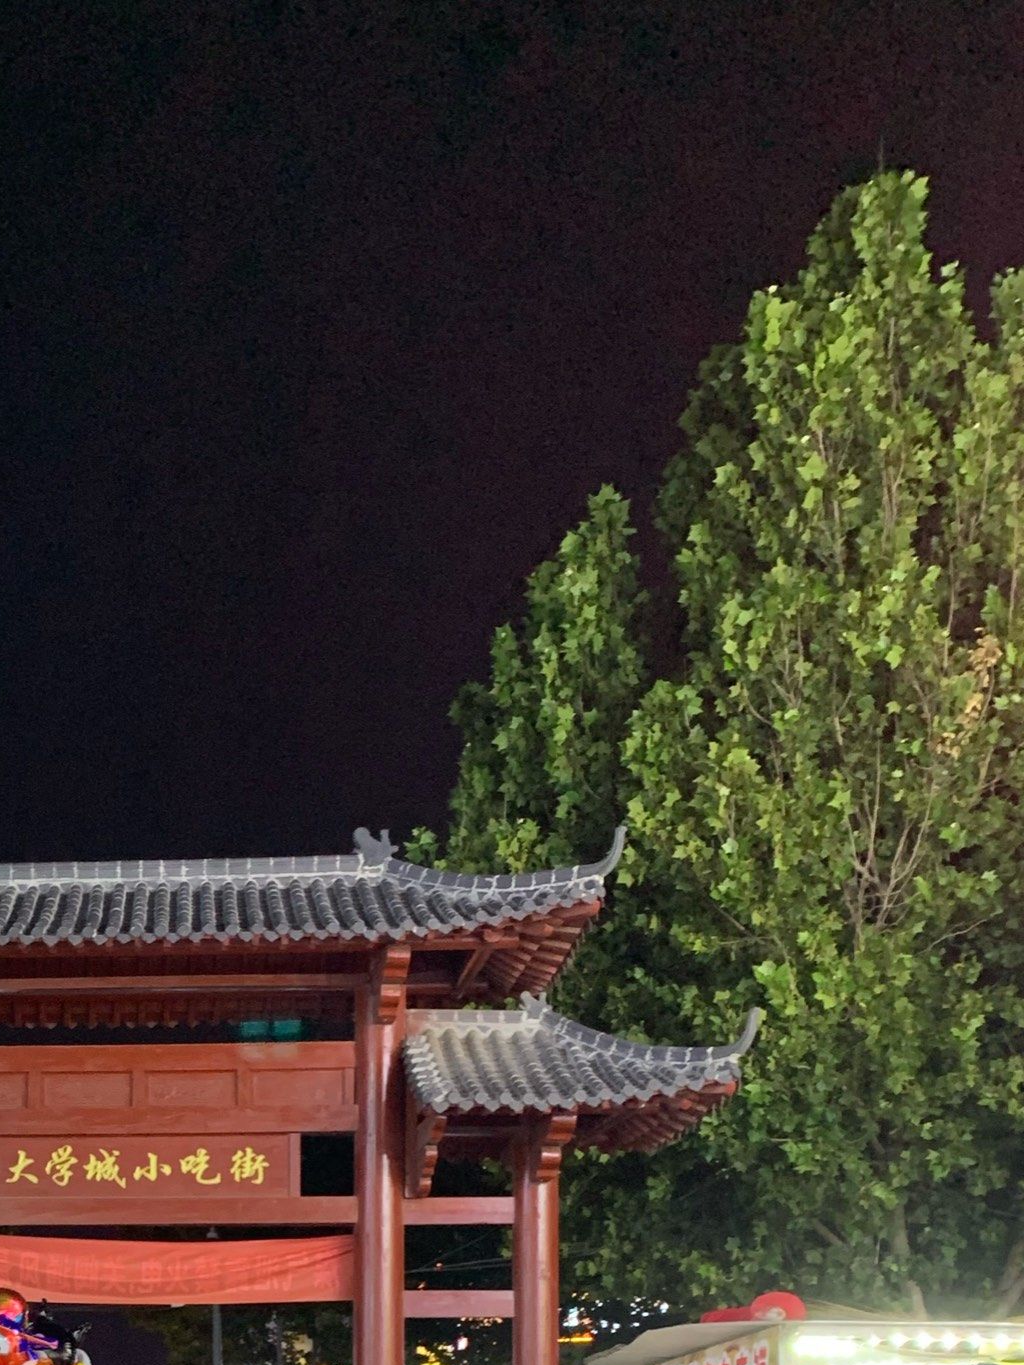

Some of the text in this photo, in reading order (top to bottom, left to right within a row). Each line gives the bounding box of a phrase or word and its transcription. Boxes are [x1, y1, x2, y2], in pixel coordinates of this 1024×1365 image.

[5, 1144, 270, 1189] 大学城小吃街
